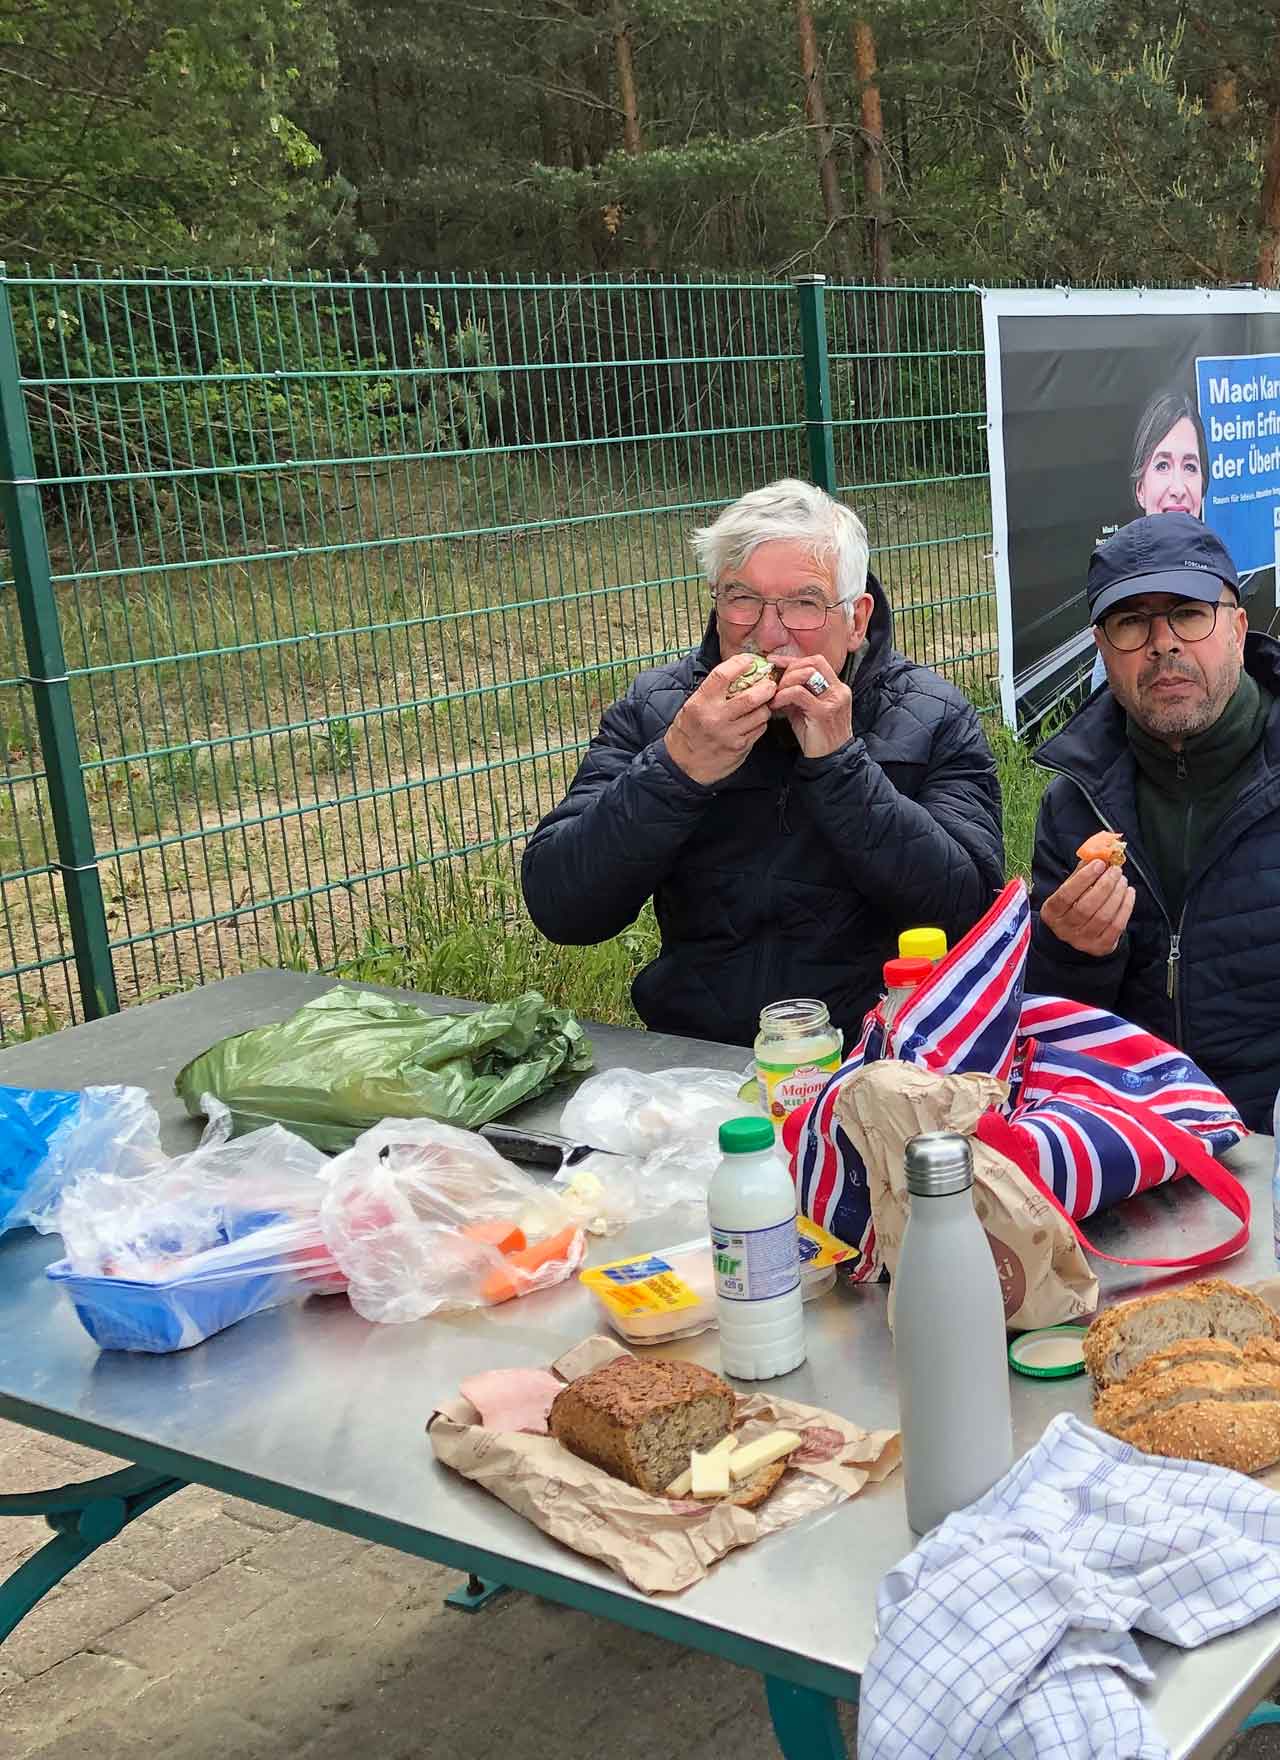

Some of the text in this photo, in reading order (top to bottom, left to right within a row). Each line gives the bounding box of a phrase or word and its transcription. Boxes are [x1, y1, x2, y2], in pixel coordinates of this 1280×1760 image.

[1208, 375, 1259, 404] Mach
[1210, 415, 1256, 442] beim
[1211, 453, 1245, 480] der
[712, 1251, 741, 1276] fir
[737, 1283, 744, 1293] g
